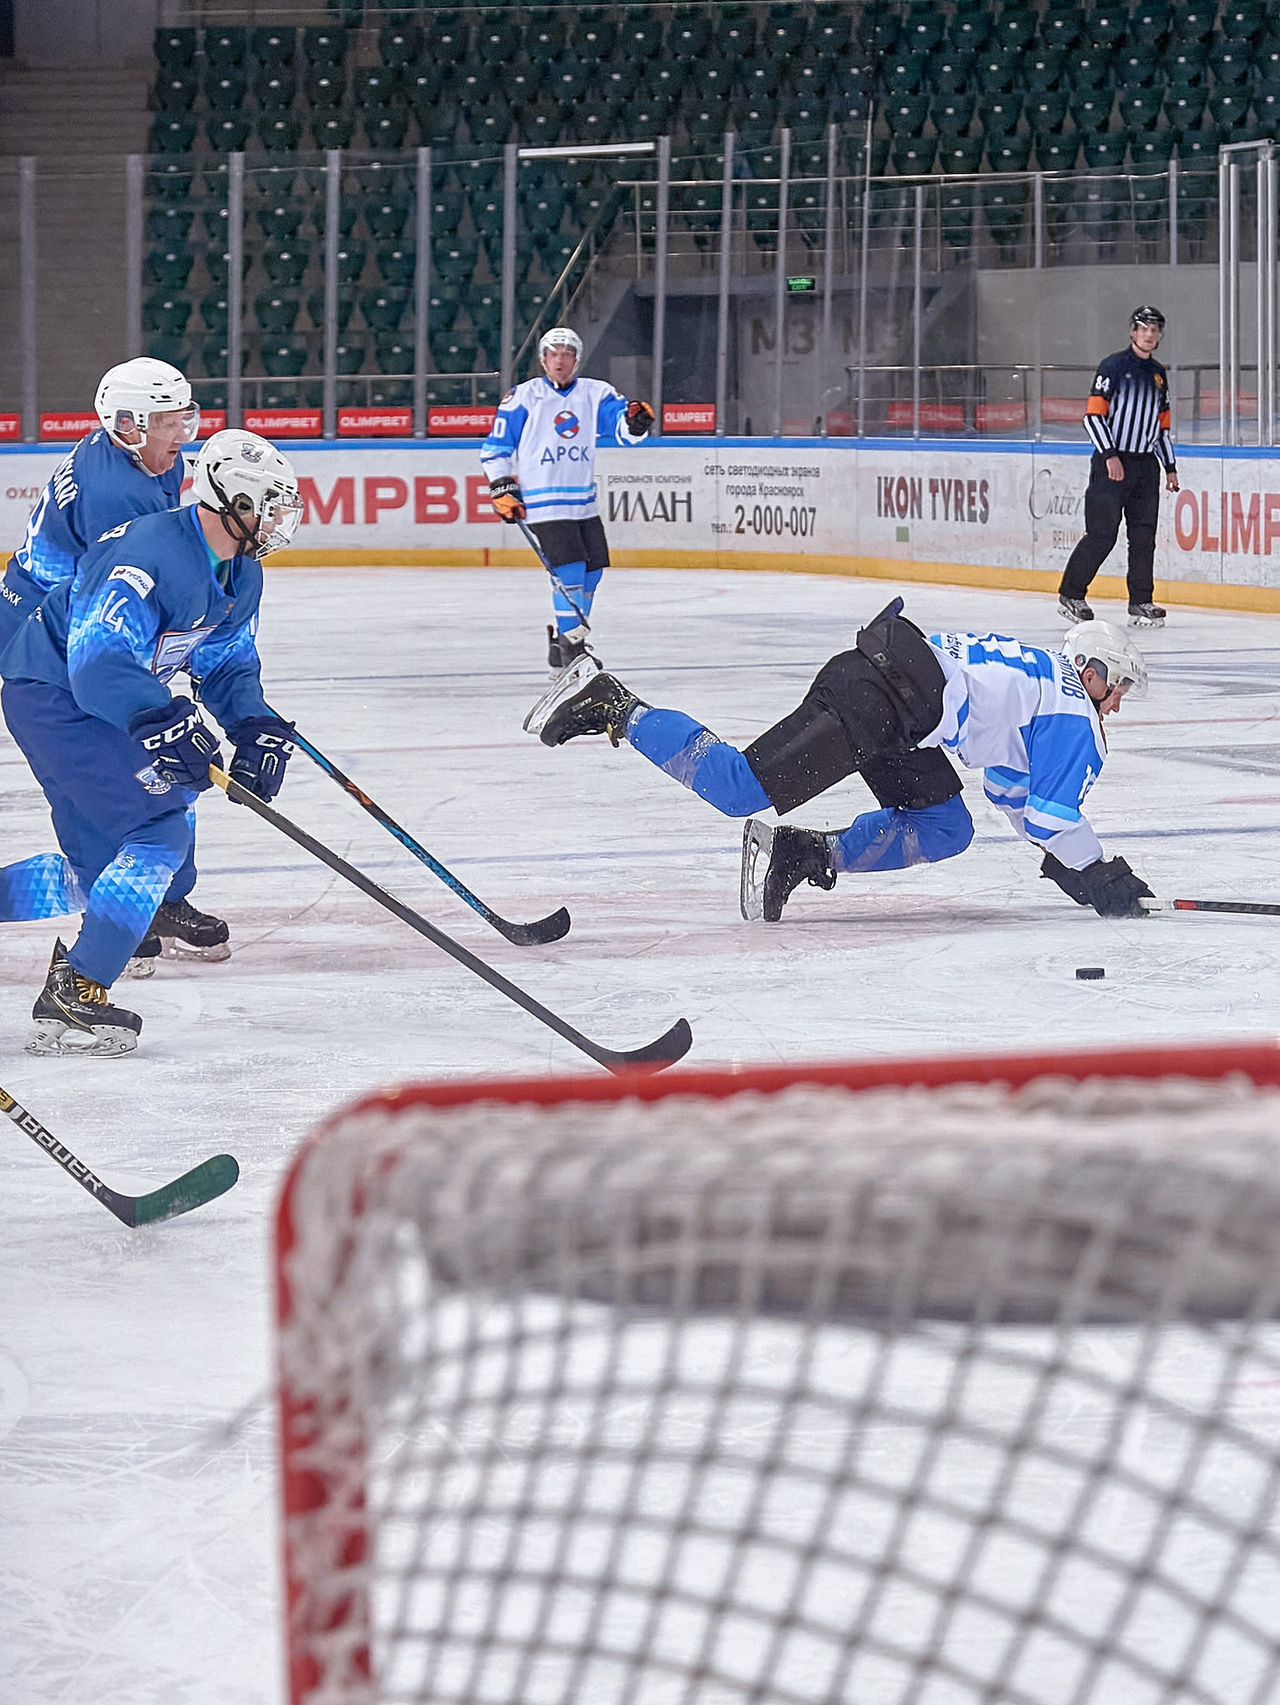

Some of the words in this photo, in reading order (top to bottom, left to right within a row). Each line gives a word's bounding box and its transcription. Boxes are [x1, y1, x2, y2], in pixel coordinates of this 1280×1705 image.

[1095, 375, 1110, 392] 84
[246, 417, 319, 429] OLIMPBET
[340, 415, 409, 427] OLIMPBET
[430, 414, 496, 426] OLIMPBET
[664, 411, 714, 424] OLIMPBET
[43, 420, 100, 431] OLIMPB
[704, 465, 726, 476] сеть
[728, 465, 789, 479] светодиодных
[726, 484, 756, 497] города
[608, 491, 692, 522] ИЛАН
[877, 476, 923, 519] IKON
[929, 478, 989, 524] TYRES
[735, 505, 816, 536] 2-000-007
[141, 709, 204, 751] CCM
